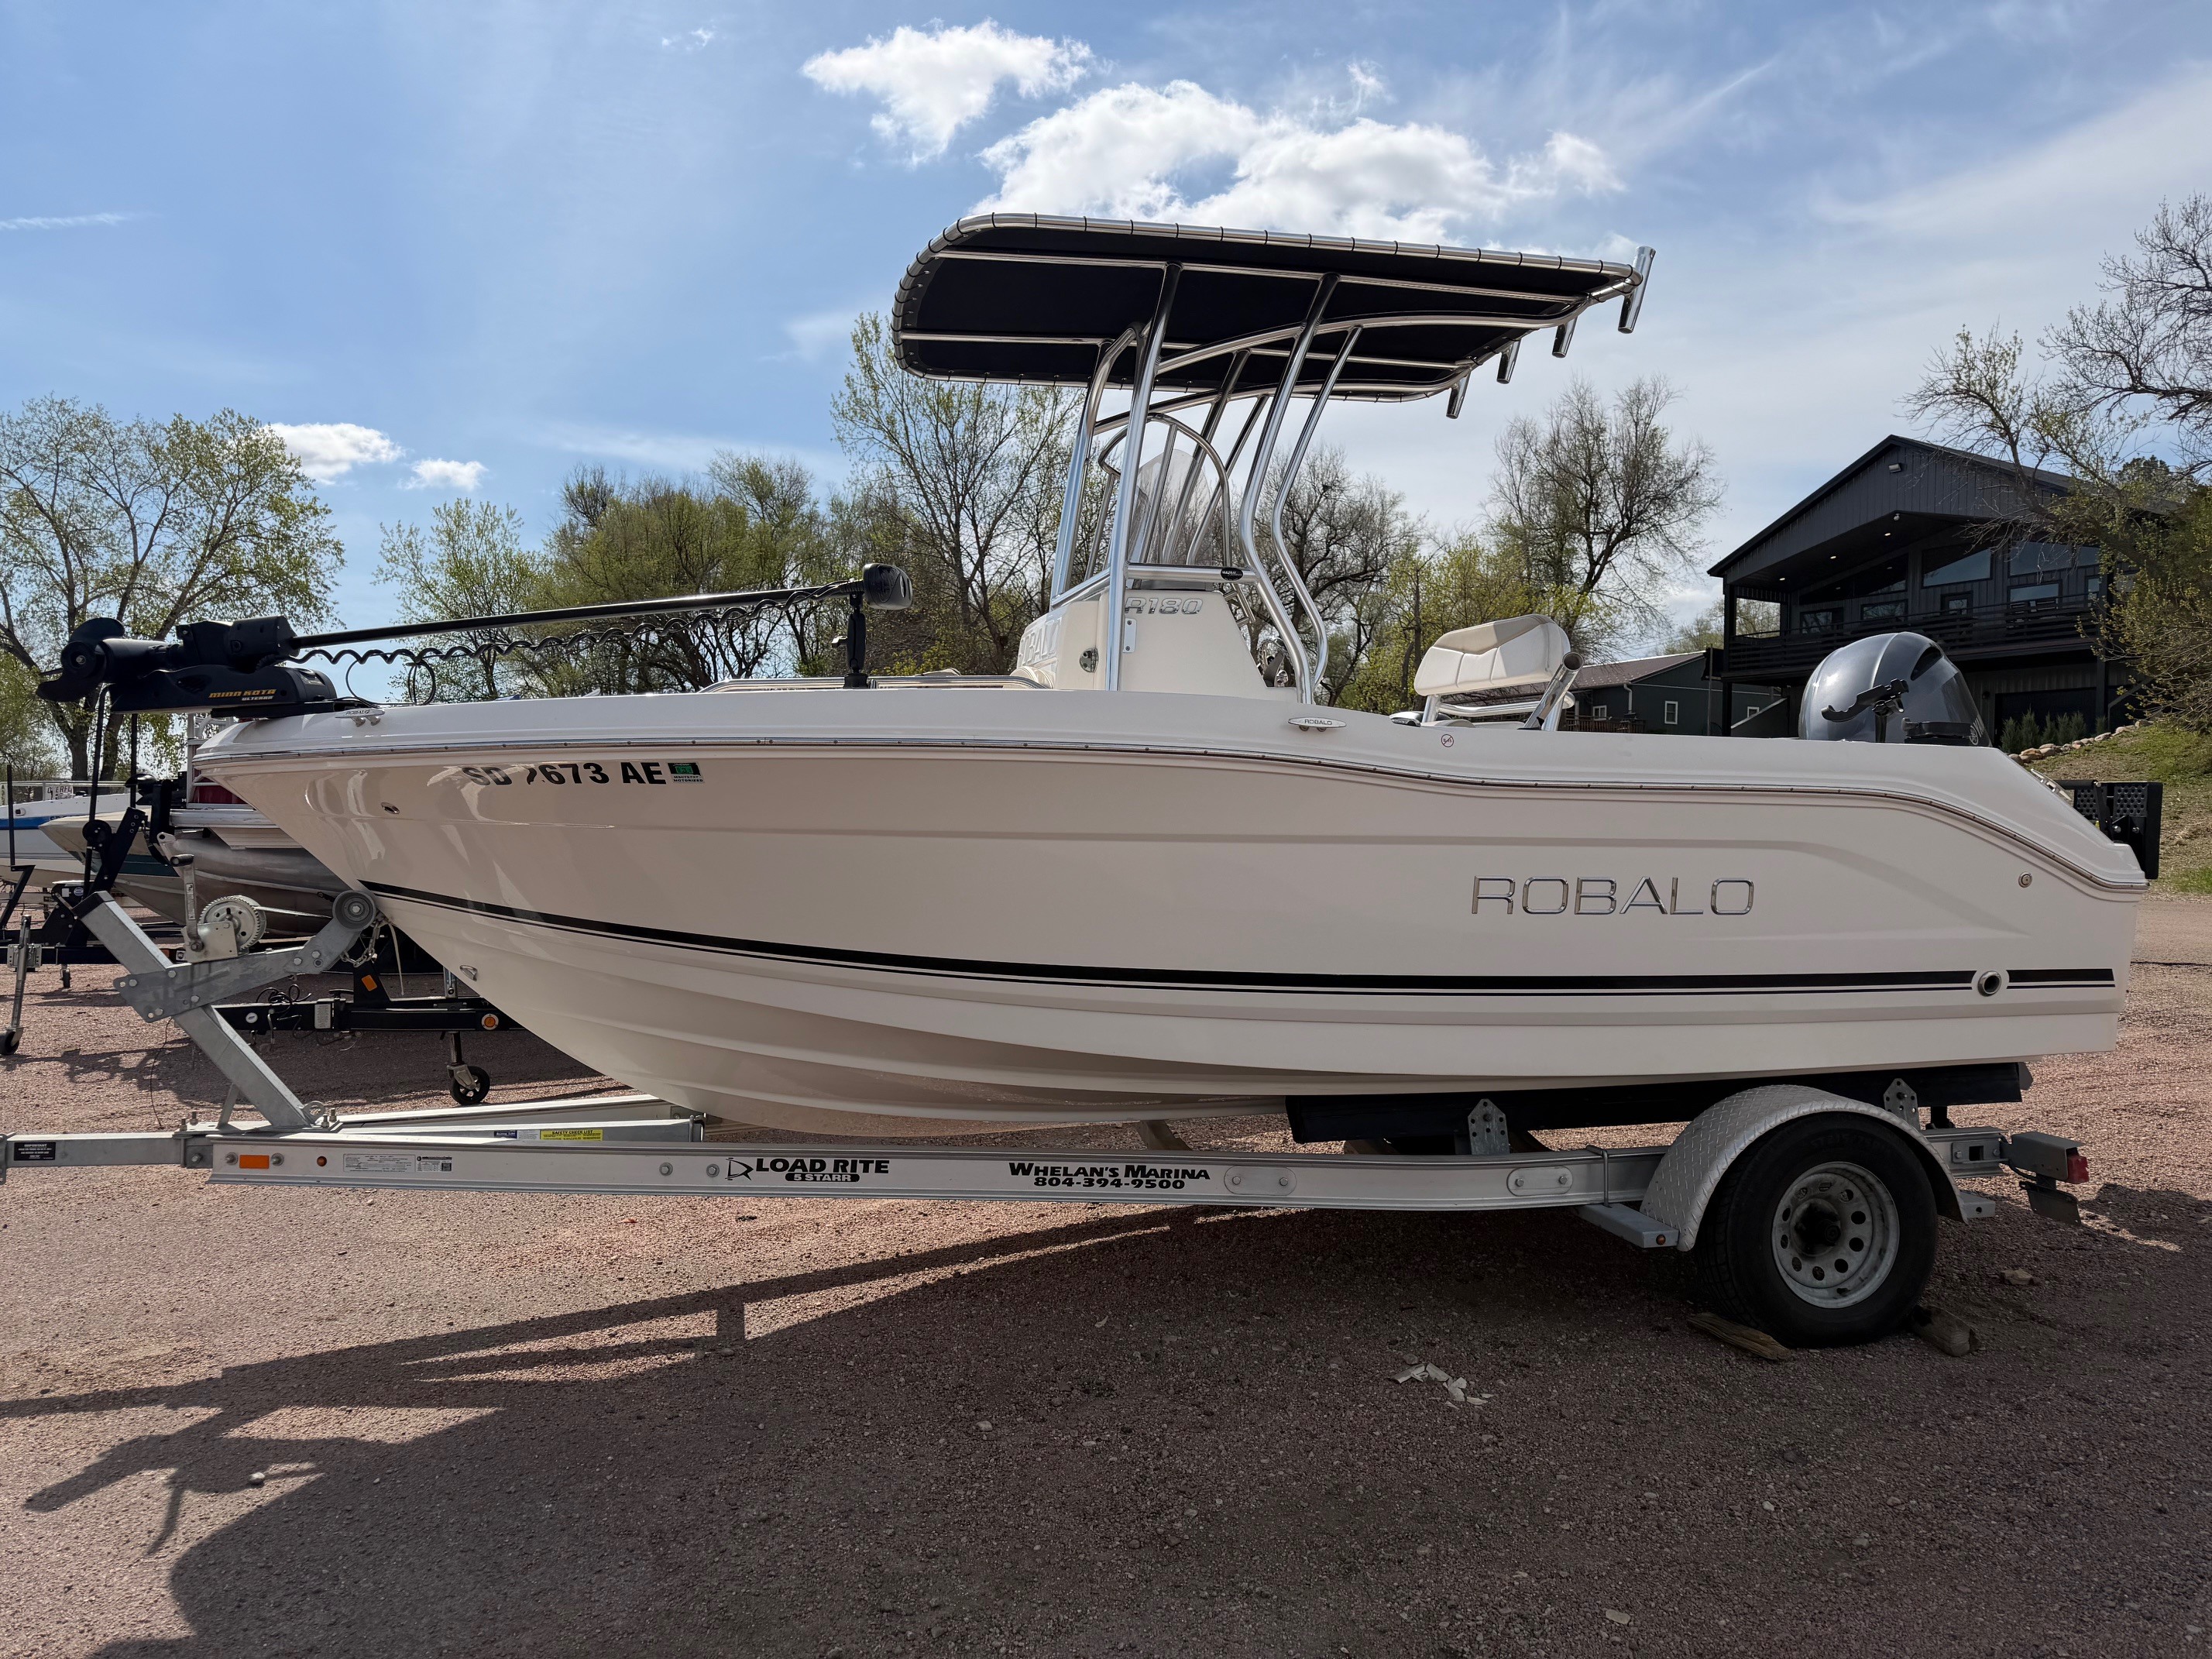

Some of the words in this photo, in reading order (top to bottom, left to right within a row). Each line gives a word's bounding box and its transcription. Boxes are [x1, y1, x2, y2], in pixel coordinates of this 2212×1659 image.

[1125, 597, 1204, 614] R180
[462, 766, 513, 785] SD
[620, 762, 666, 785] AE
[1472, 875, 1755, 915] ROBALO
[756, 1158, 826, 1173] LOAD
[833, 1159, 890, 1174] RITE
[1008, 1163, 1119, 1178] WHELAN'S
[1124, 1164, 1211, 1180] MARINA
[805, 1173, 852, 1182] STARR
[1033, 1177, 1186, 1190] 804-394-9500
